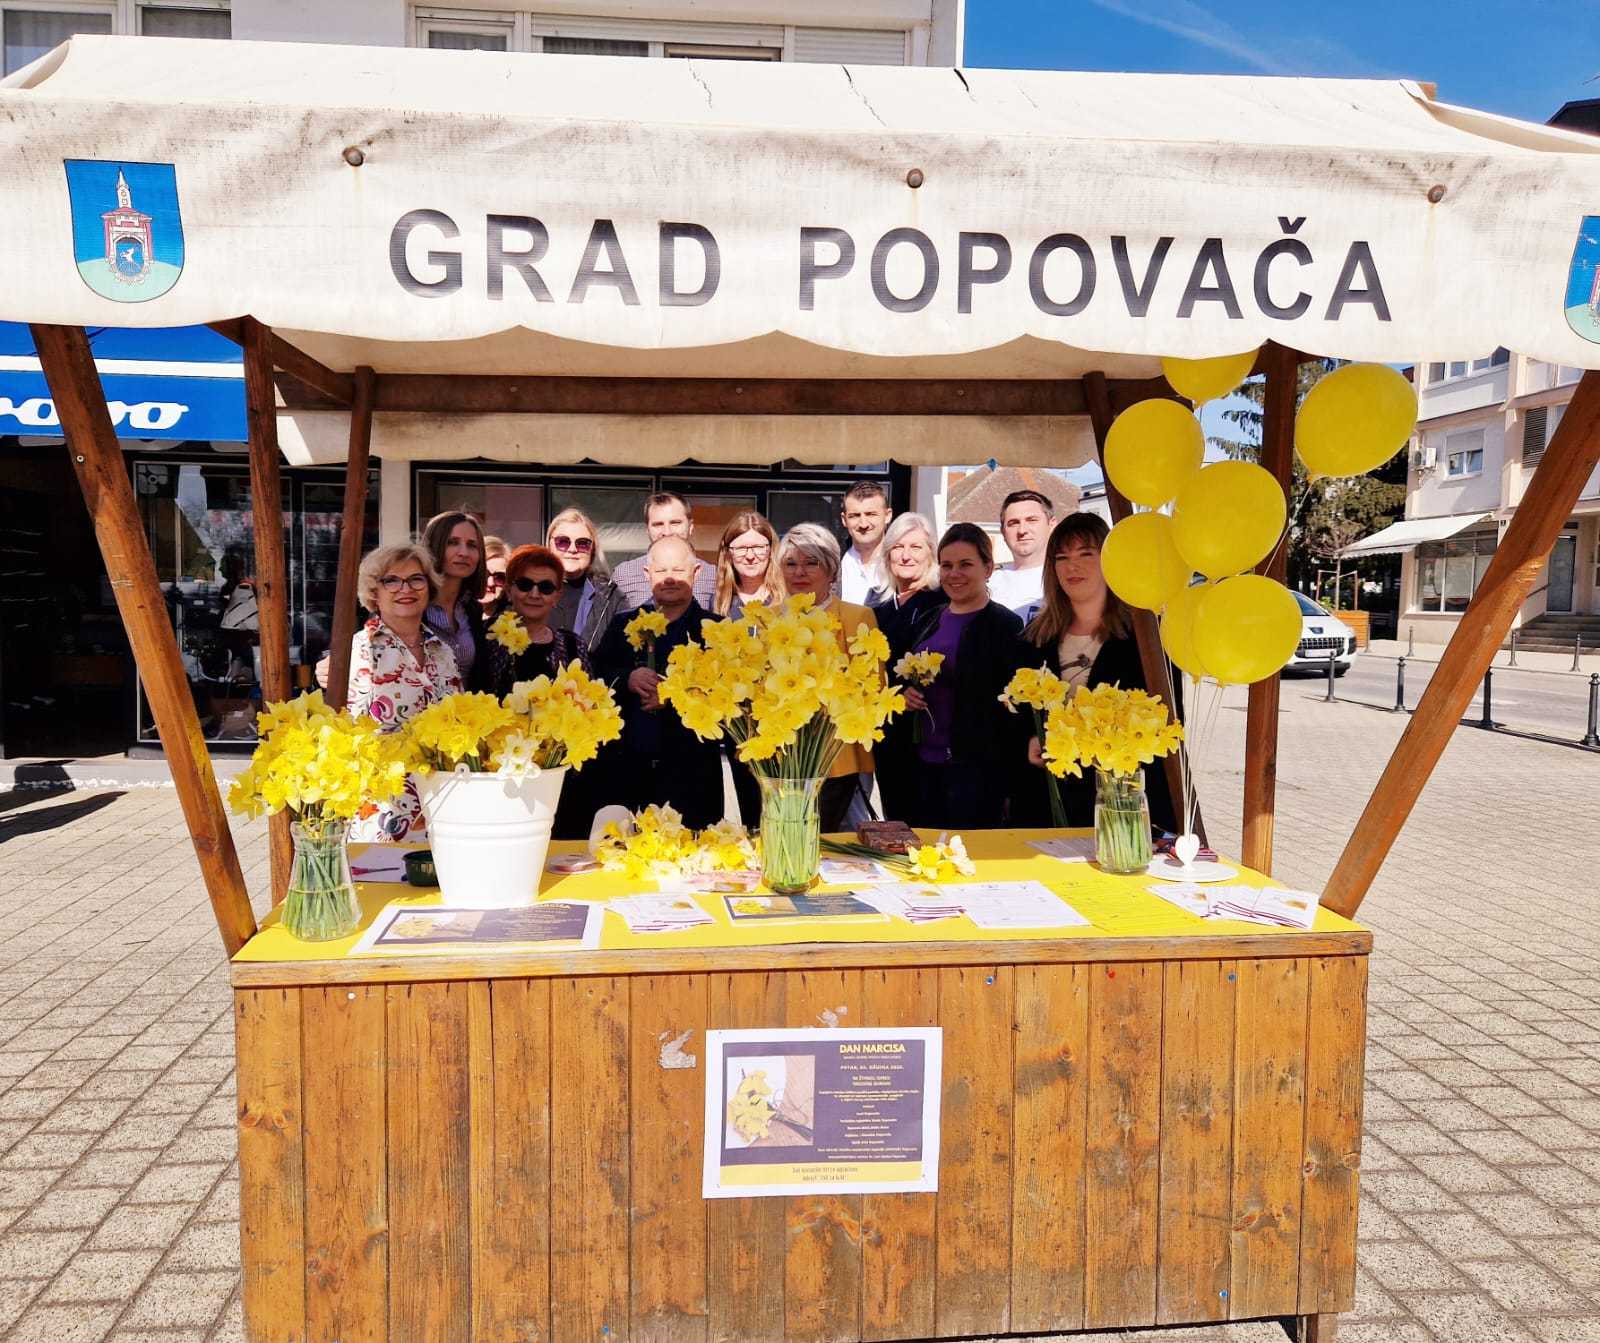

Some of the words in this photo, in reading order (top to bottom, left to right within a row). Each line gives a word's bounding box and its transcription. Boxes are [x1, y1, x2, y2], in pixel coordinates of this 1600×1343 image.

[389, 208, 721, 307] GRAD
[798, 216, 1392, 322] POPOVAČA
[839, 1042, 861, 1054] DAN
[862, 1041, 906, 1054] NARCISA
